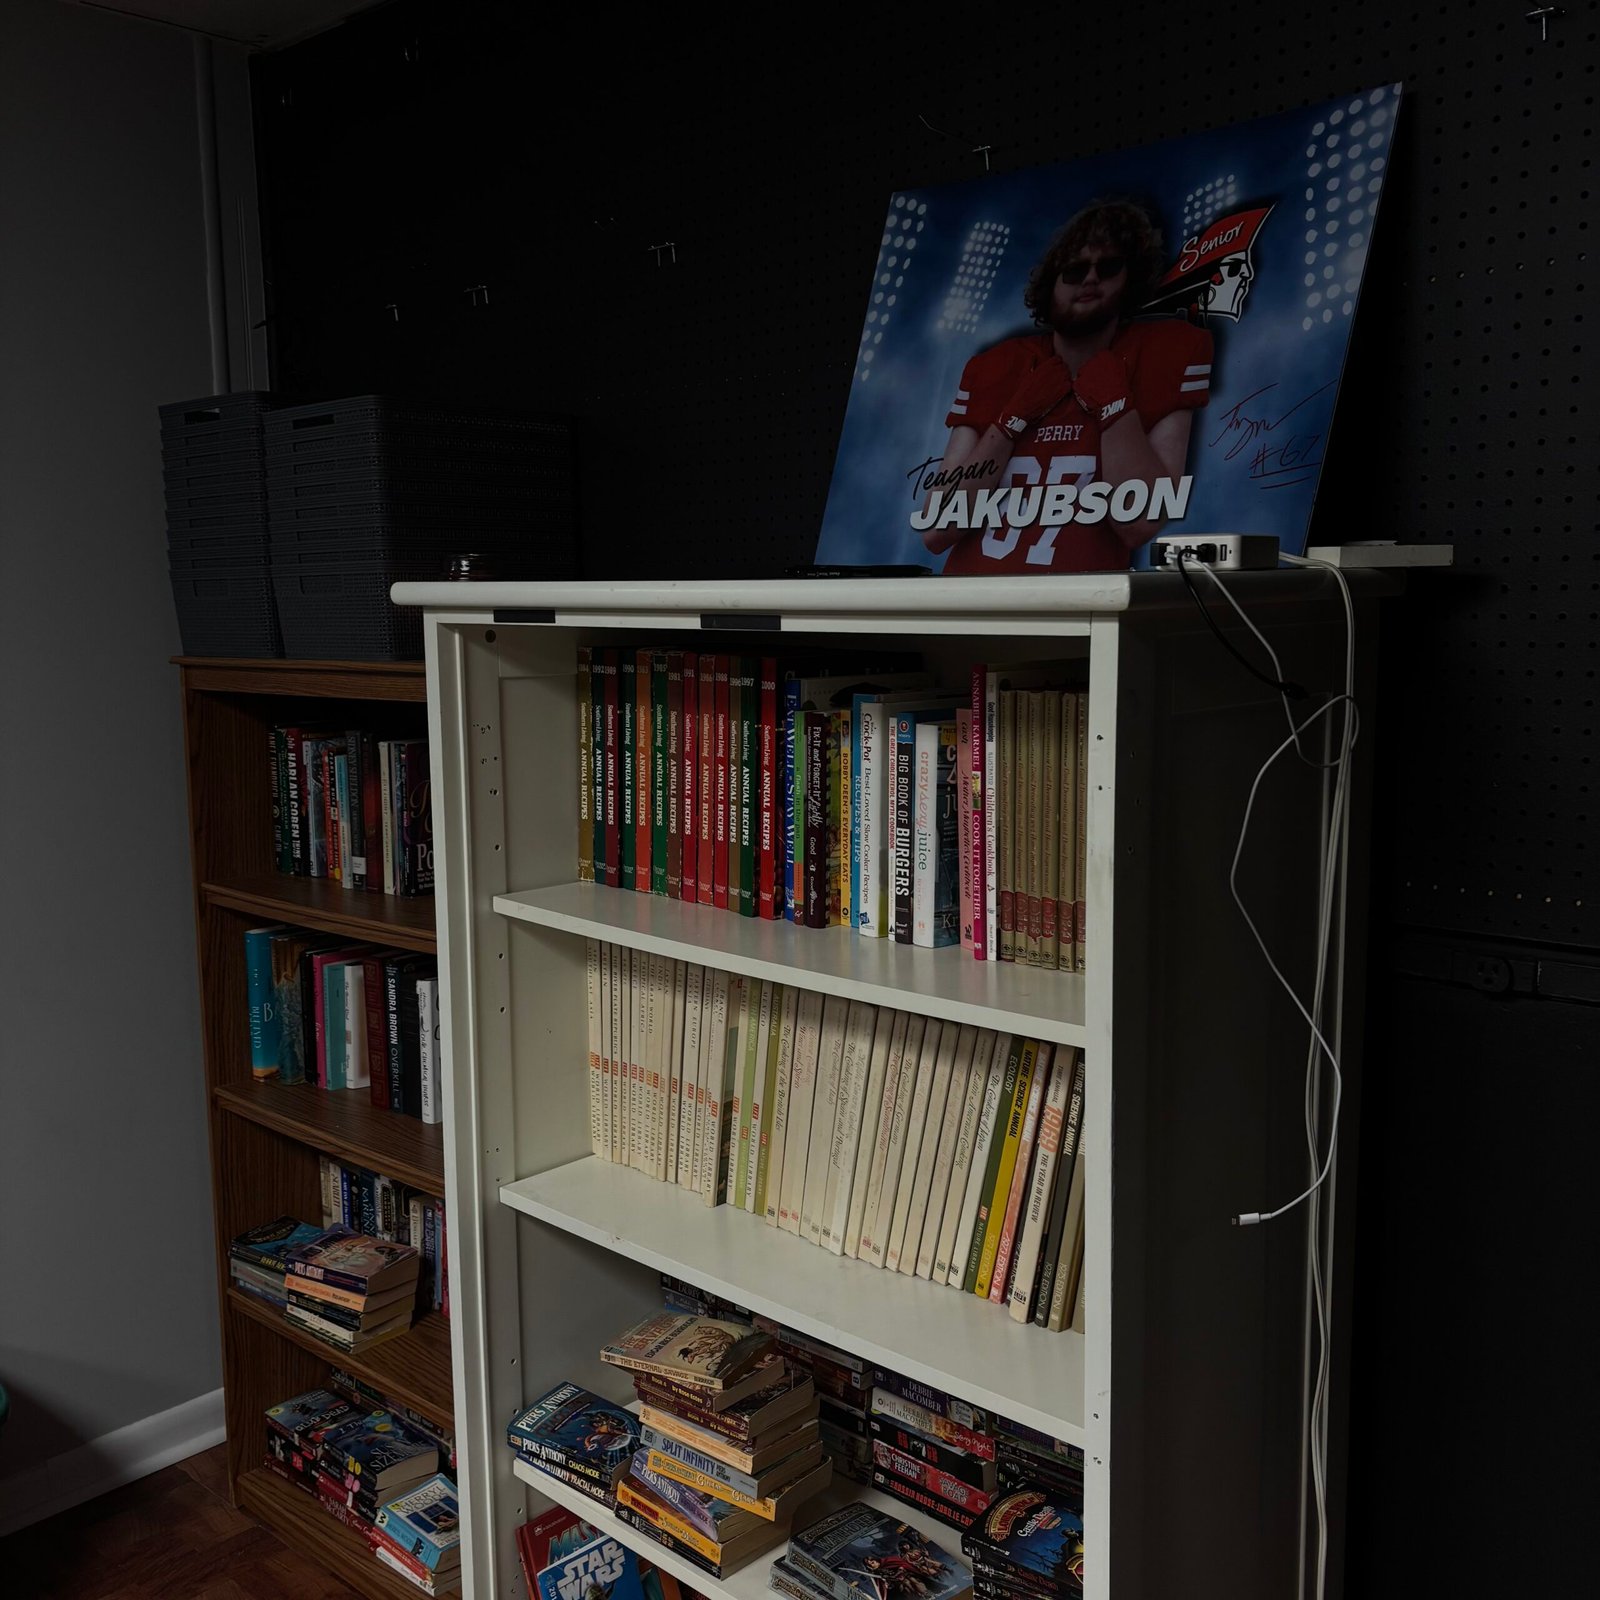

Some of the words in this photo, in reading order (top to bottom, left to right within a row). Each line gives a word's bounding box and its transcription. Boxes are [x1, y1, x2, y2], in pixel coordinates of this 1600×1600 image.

[1180, 221, 1244, 272] Senior
[1034, 425, 1084, 443] PERRY
[908, 457, 999, 510] Teagan
[910, 475, 1193, 531] JAKUBSON
[987, 702, 995, 712] Good
[987, 714, 995, 742] Housekeeping
[813, 748, 821, 760] and
[898, 755, 909, 772] BIG
[287, 753, 298, 799] HARLAN
[898, 777, 909, 807] BOOK
[290, 801, 300, 838] COBEN
[809, 797, 824, 827] Lightly
[898, 810, 909, 824] OF
[987, 788, 995, 832] Children's
[854, 826, 861, 834] &
[896, 828, 910, 896] BURGERS
[973, 850, 980, 860] IT
[987, 835, 995, 876] Cookbook
[387, 978, 397, 1011] SANDRA
[760, 991, 768, 1027] MEXICO
[389, 1013, 398, 1045] BROWN
[770, 993, 780, 1036] AUSTRALIA
[391, 1048, 400, 1093] OVERKILL
[1004, 1055, 1018, 1094] ECOLOGY
[1021, 1049, 1033, 1079] NATURE
[1072, 1062, 1085, 1092] NATURE
[1014, 1080, 1027, 1109] SCIENCE
[1052, 1080, 1063, 1103] ANNUAL
[1009, 1109, 1021, 1138] ANNUAL
[1067, 1093, 1081, 1126] SCIENCE
[1040, 1104, 1063, 1153] 1969
[1063, 1125, 1076, 1156] ANNUAL
[1040, 1154, 1049, 1166] THE
[746, 1160, 754, 1197] LIBRARY
[1035, 1188, 1043, 1196] IN
[1037, 1168, 1048, 1186] YEAR
[1031, 1195, 1042, 1222] REVIEW
[974, 1222, 984, 1244] NATURE
[970, 1247, 980, 1272] LIBRARY
[1038, 1279, 1050, 1308] EDITION
[902, 1387, 942, 1413] MACOMBER
[909, 1381, 934, 1399] DEBBIE
[518, 1408, 546, 1432] PIERS
[542, 1385, 580, 1412] ANTHONY
[522, 1438, 541, 1454] PIERS
[540, 1445, 567, 1464] ANTHONY
[568, 1460, 585, 1475] CHAOS
[584, 1467, 601, 1479] MODE
[662, 1438, 682, 1456] SPLIT
[683, 1448, 717, 1475] INFINITY
[891, 1453, 921, 1473] CHRISTINE
[894, 1462, 917, 1479] FEEHAN
[590, 1485, 605, 1499] MODE
[557, 1540, 625, 1588] STAR
[557, 1557, 626, 1600] WARS
